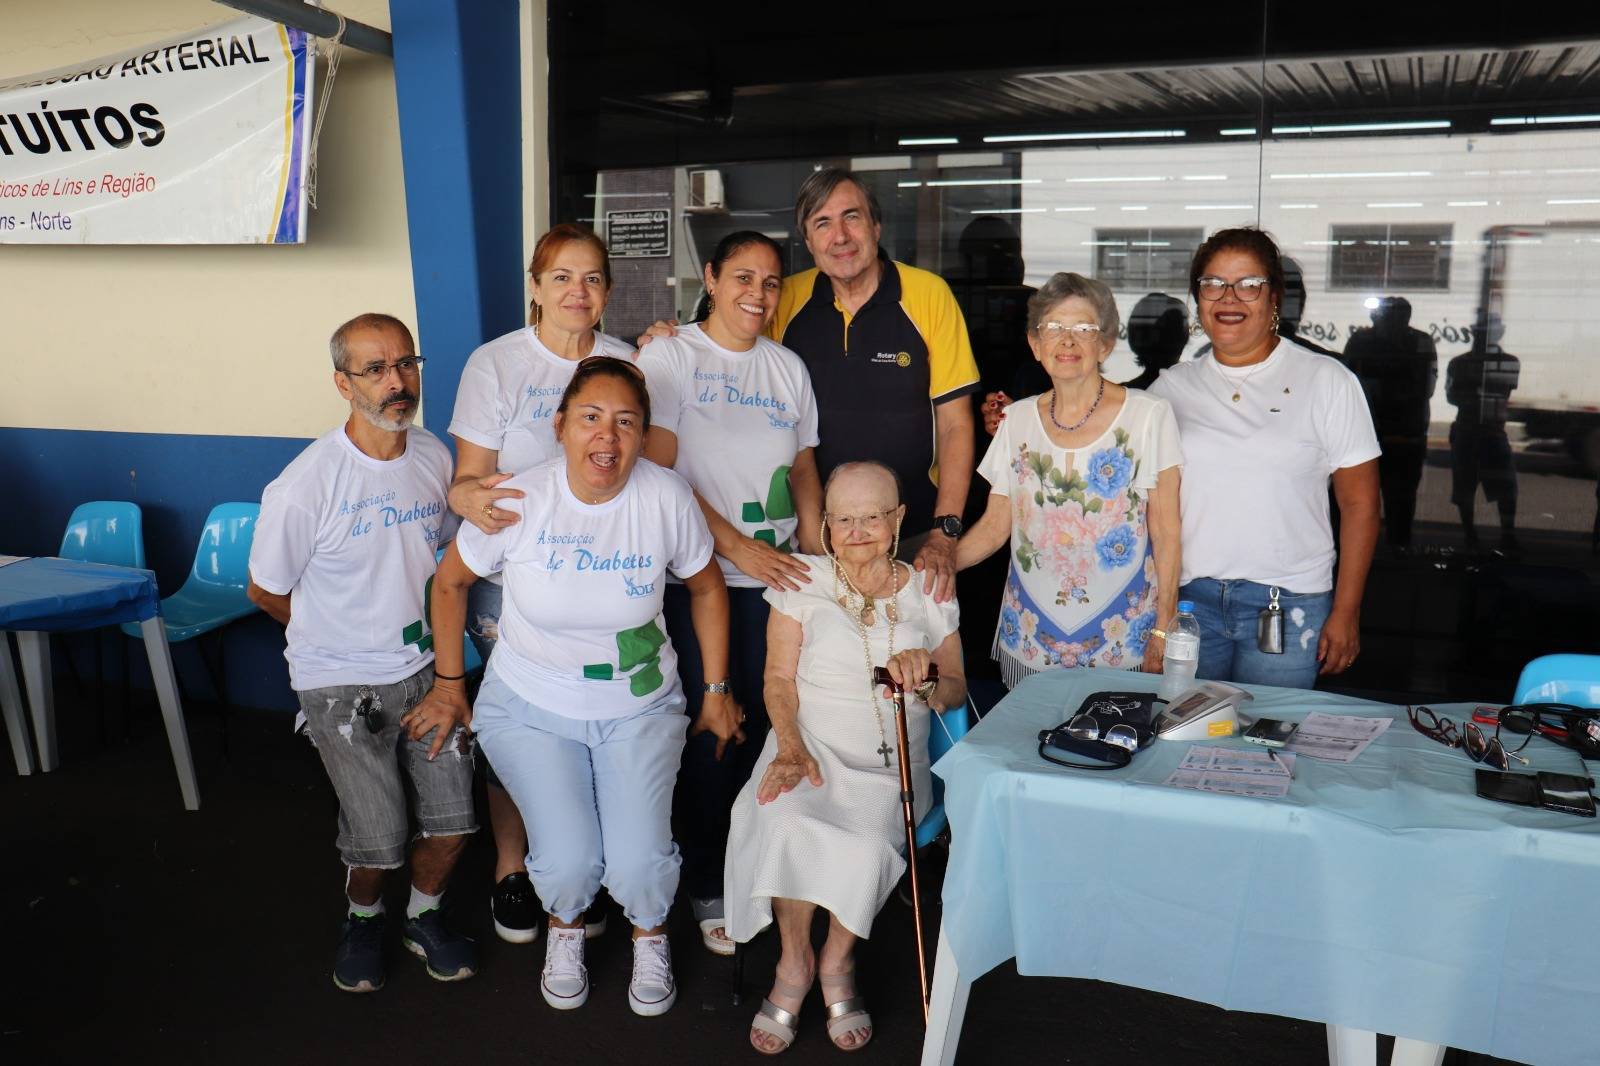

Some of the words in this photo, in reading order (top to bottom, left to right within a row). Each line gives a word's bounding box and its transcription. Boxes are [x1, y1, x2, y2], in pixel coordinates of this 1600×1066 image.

[120, 34, 270, 78] ARTERIAL
[0, 181, 29, 198] icos
[32, 180, 50, 197] de
[53, 178, 83, 196] Lins
[86, 179, 97, 194] e
[100, 172, 156, 198] Região
[31, 211, 72, 231] Norte
[876, 352, 897, 360] Rotary
[693, 366, 739, 384] Associação
[527, 384, 565, 397] Associa
[699, 383, 718, 403] de
[725, 385, 786, 412] Diabetes
[533, 401, 552, 419] de
[340, 489, 397, 515] Associação
[352, 516, 372, 537] de
[381, 501, 441, 528] Diabetes
[536, 529, 595, 547] Associação
[546, 550, 564, 571] de
[574, 548, 652, 572] Diabetes
